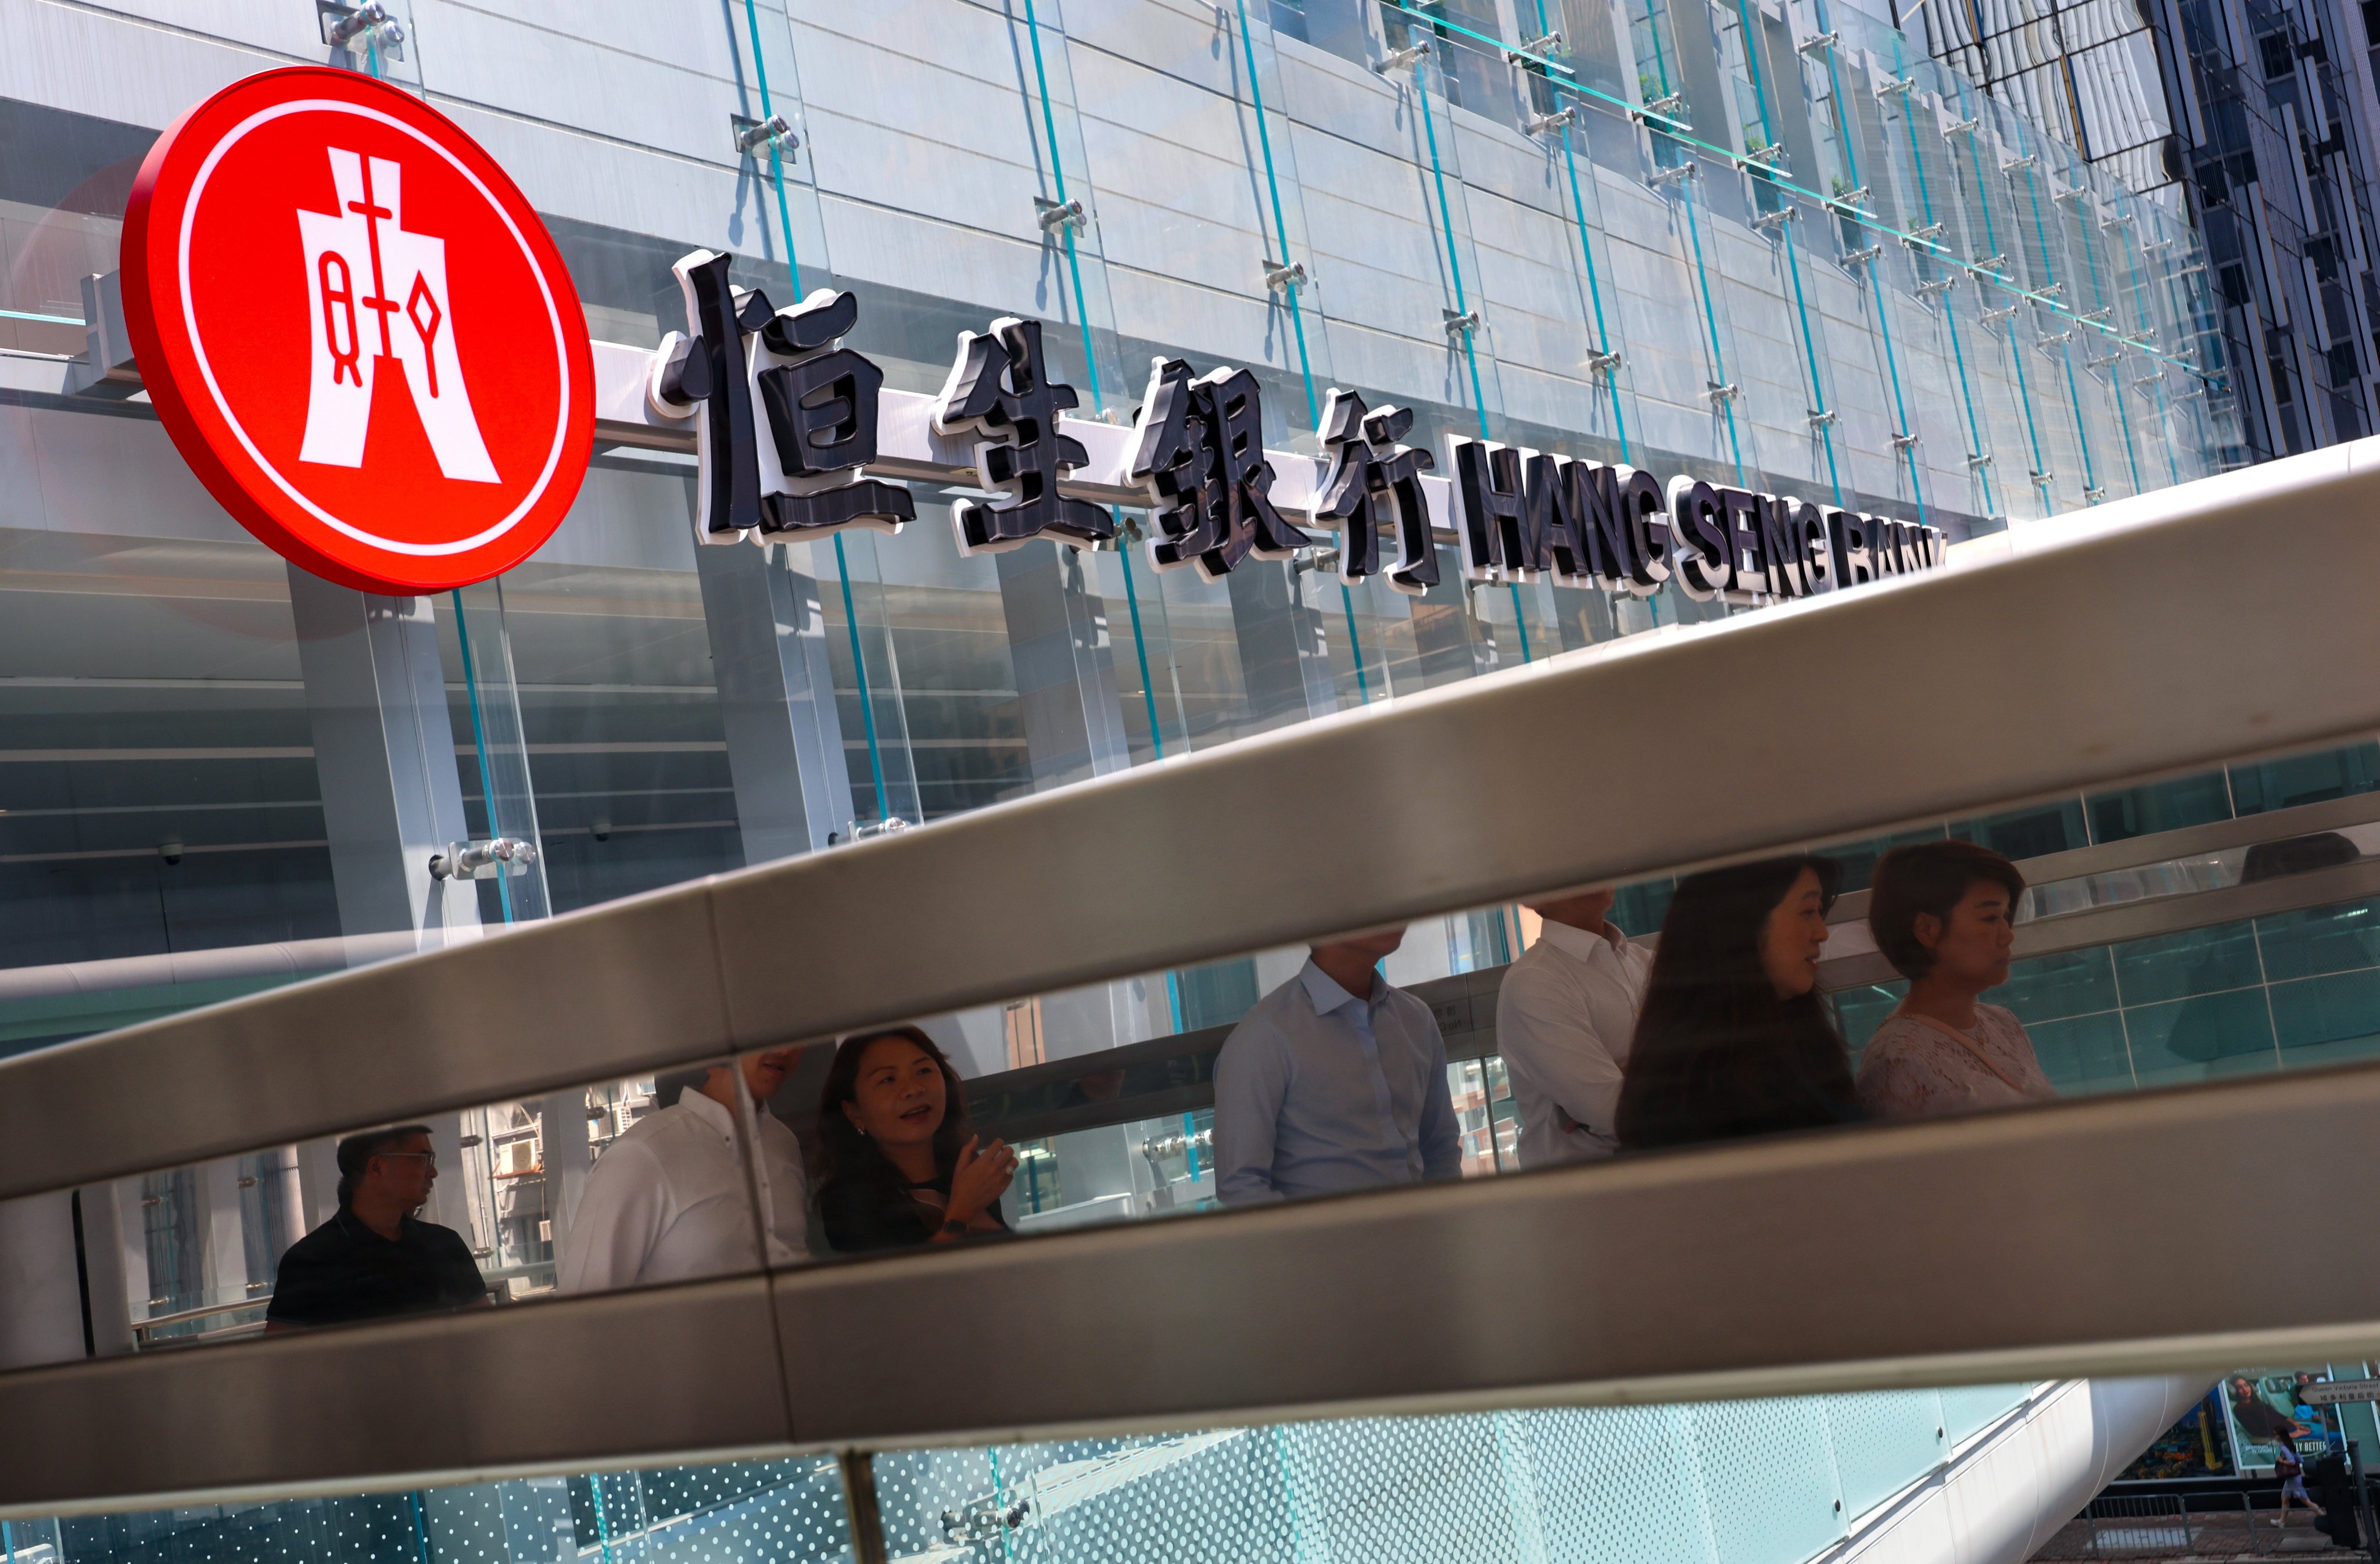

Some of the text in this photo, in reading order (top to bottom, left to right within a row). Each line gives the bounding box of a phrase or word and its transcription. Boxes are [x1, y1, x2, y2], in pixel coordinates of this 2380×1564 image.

[650, 250, 1440, 589] 恒生銀行
[1453, 437, 1673, 589] HANG
[1673, 478, 1832, 600] SENG
[2294, 1441, 2303, 1452] LY
